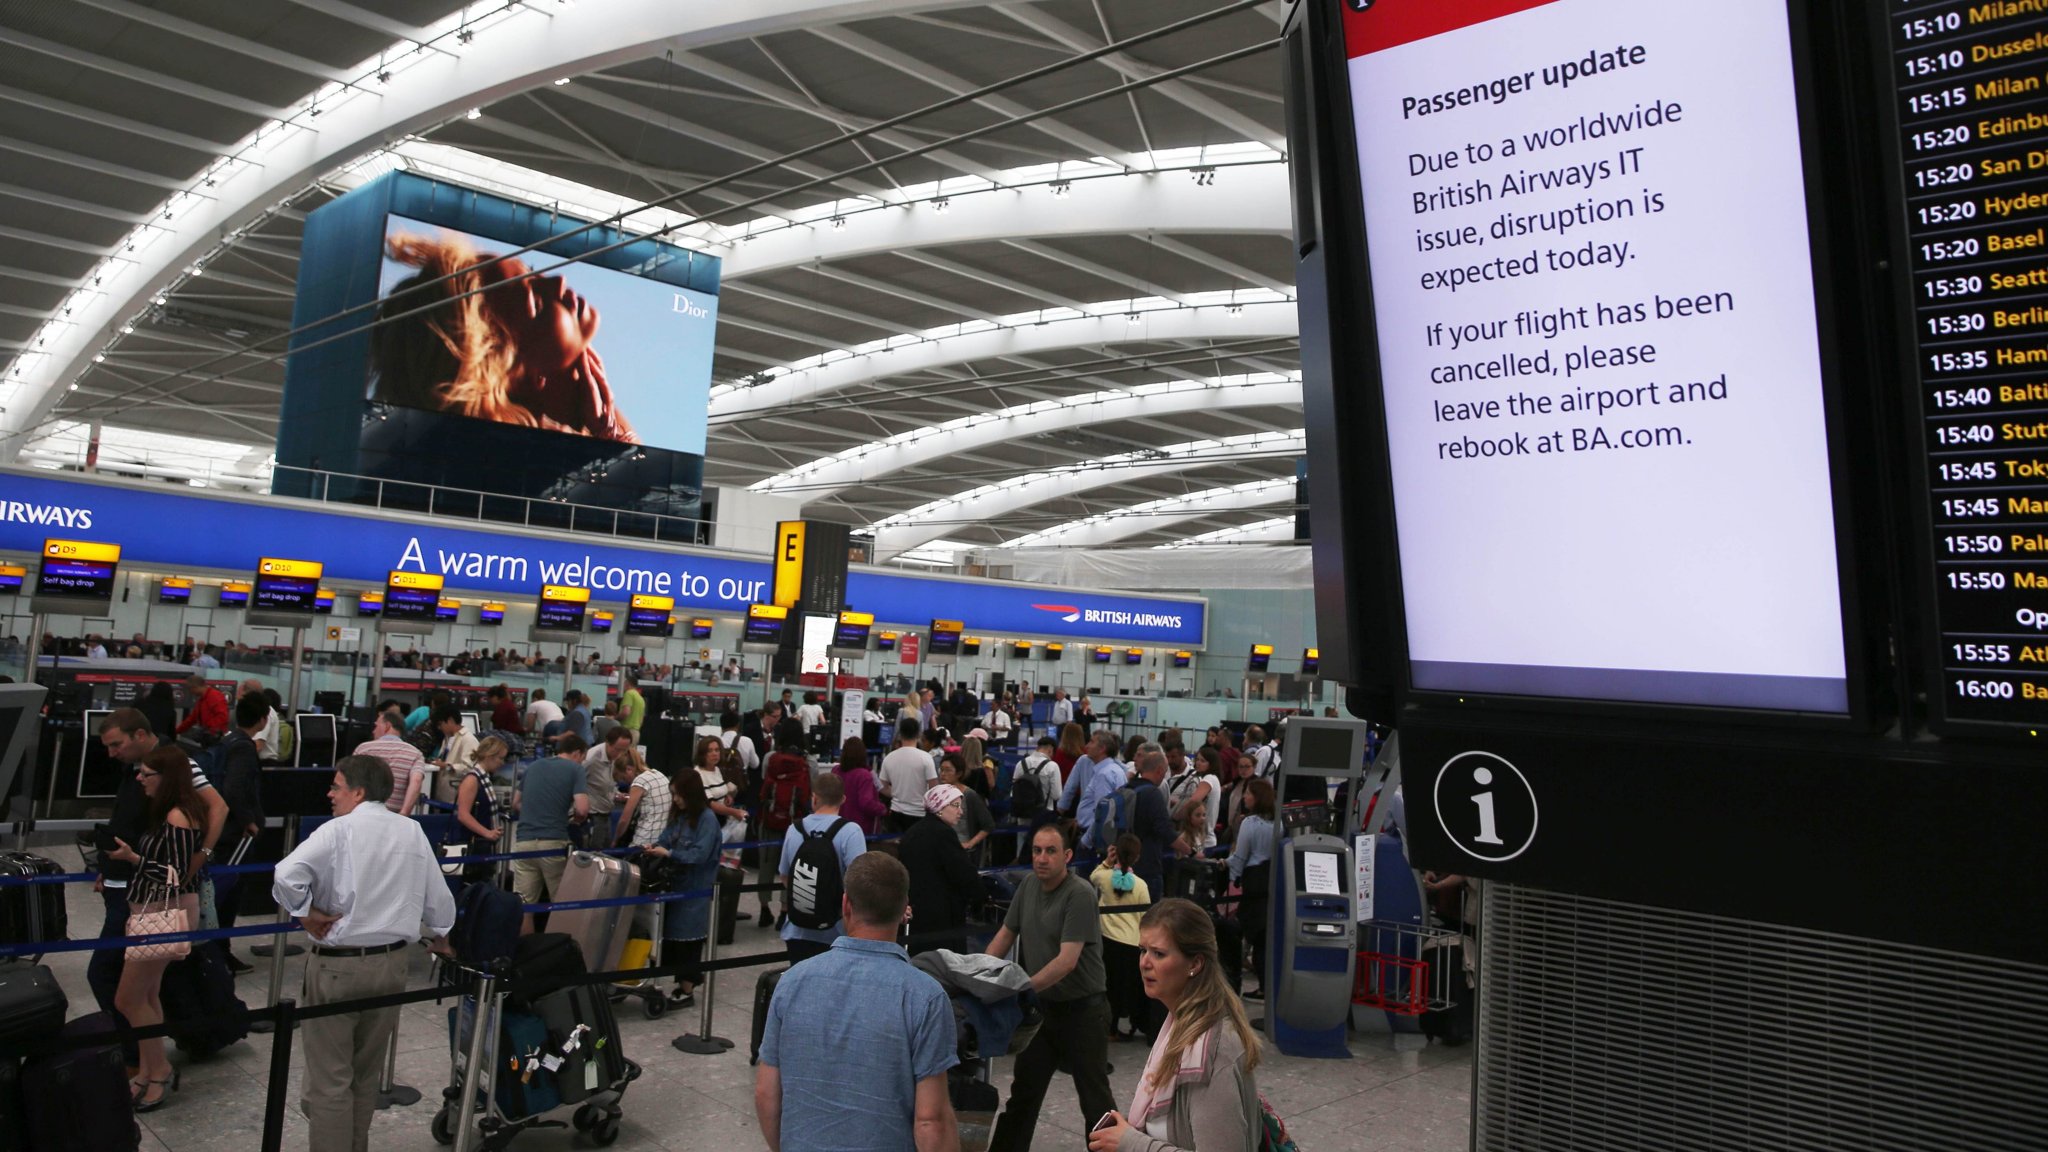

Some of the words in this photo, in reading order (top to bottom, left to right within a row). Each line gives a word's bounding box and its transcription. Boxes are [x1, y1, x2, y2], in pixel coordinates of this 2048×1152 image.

[1902, 12, 1961, 40] 15:10
[1905, 50, 1964, 77] 15:10
[1402, 71, 1535, 120] Passenger
[1543, 45, 1647, 88] update
[1909, 87, 1966, 113] 15:15
[1975, 76, 2039, 100] Milan
[1408, 151, 1459, 177] Due
[1465, 142, 1493, 165] to
[1501, 138, 1517, 158] a
[1524, 100, 1683, 152] worldwide
[1912, 125, 1970, 150] 15:20
[1412, 179, 1492, 214] British
[1500, 159, 1611, 197] Airways
[1619, 148, 1645, 175] IT
[1915, 163, 1973, 188] 15:20
[1980, 158, 2021, 176] San
[1416, 225, 1485, 252] issue,
[1490, 198, 1634, 239] disruption
[1643, 188, 1665, 214] is
[1918, 201, 1976, 225] 15:20
[1921, 238, 1979, 261] 15:20
[1987, 228, 2044, 252] Basel
[1420, 250, 1540, 292] expected
[1546, 241, 1636, 272] today.
[1924, 276, 1982, 298] 15:30
[671, 293, 709, 319] Dior
[1426, 323, 1443, 347] If
[1449, 318, 1508, 350] your
[1514, 306, 1589, 339] flight
[1597, 301, 1647, 326] has
[1655, 291, 1734, 319] been
[1927, 313, 1985, 335] 15:30
[1430, 350, 1558, 384] cancelled,
[1565, 343, 1657, 377] please
[1930, 350, 1988, 371] 15:35
[1997, 348, 2048, 365] Ham
[1434, 399, 1500, 422] leave
[1507, 392, 1552, 417] the
[1560, 381, 1660, 416] airport
[1668, 374, 1728, 404] and
[1933, 388, 1991, 408] 15:40
[1999, 383, 2048, 402] Balti
[1438, 431, 1531, 459] rebook
[1537, 430, 1564, 454] at
[1572, 425, 1693, 452] BA.com.
[1936, 425, 1994, 444] 15:40
[2002, 422, 2048, 440] Stut
[1939, 462, 1997, 481] 15:45
[0, 500, 92, 530] IRWAYS
[1942, 498, 2000, 516] 15:45
[62, 545, 77, 555] D9
[785, 533, 797, 562] E
[1945, 535, 2003, 553] 15:50
[43, 576, 59, 585] Self
[60, 578, 75, 587] bag
[76, 579, 95, 588] drop
[397, 537, 426, 572] A
[438, 549, 528, 581] warm
[539, 555, 672, 594] welcome
[681, 570, 710, 598] to
[718, 577, 766, 602] our
[1947, 572, 2005, 589] 15:50
[1084, 609, 1131, 625] BRITISH
[1132, 613, 1182, 629] AIRWAYS
[1953, 644, 2011, 662] 15:55
[1956, 680, 2014, 699] 16:00
[792, 858, 819, 915] NIKE
